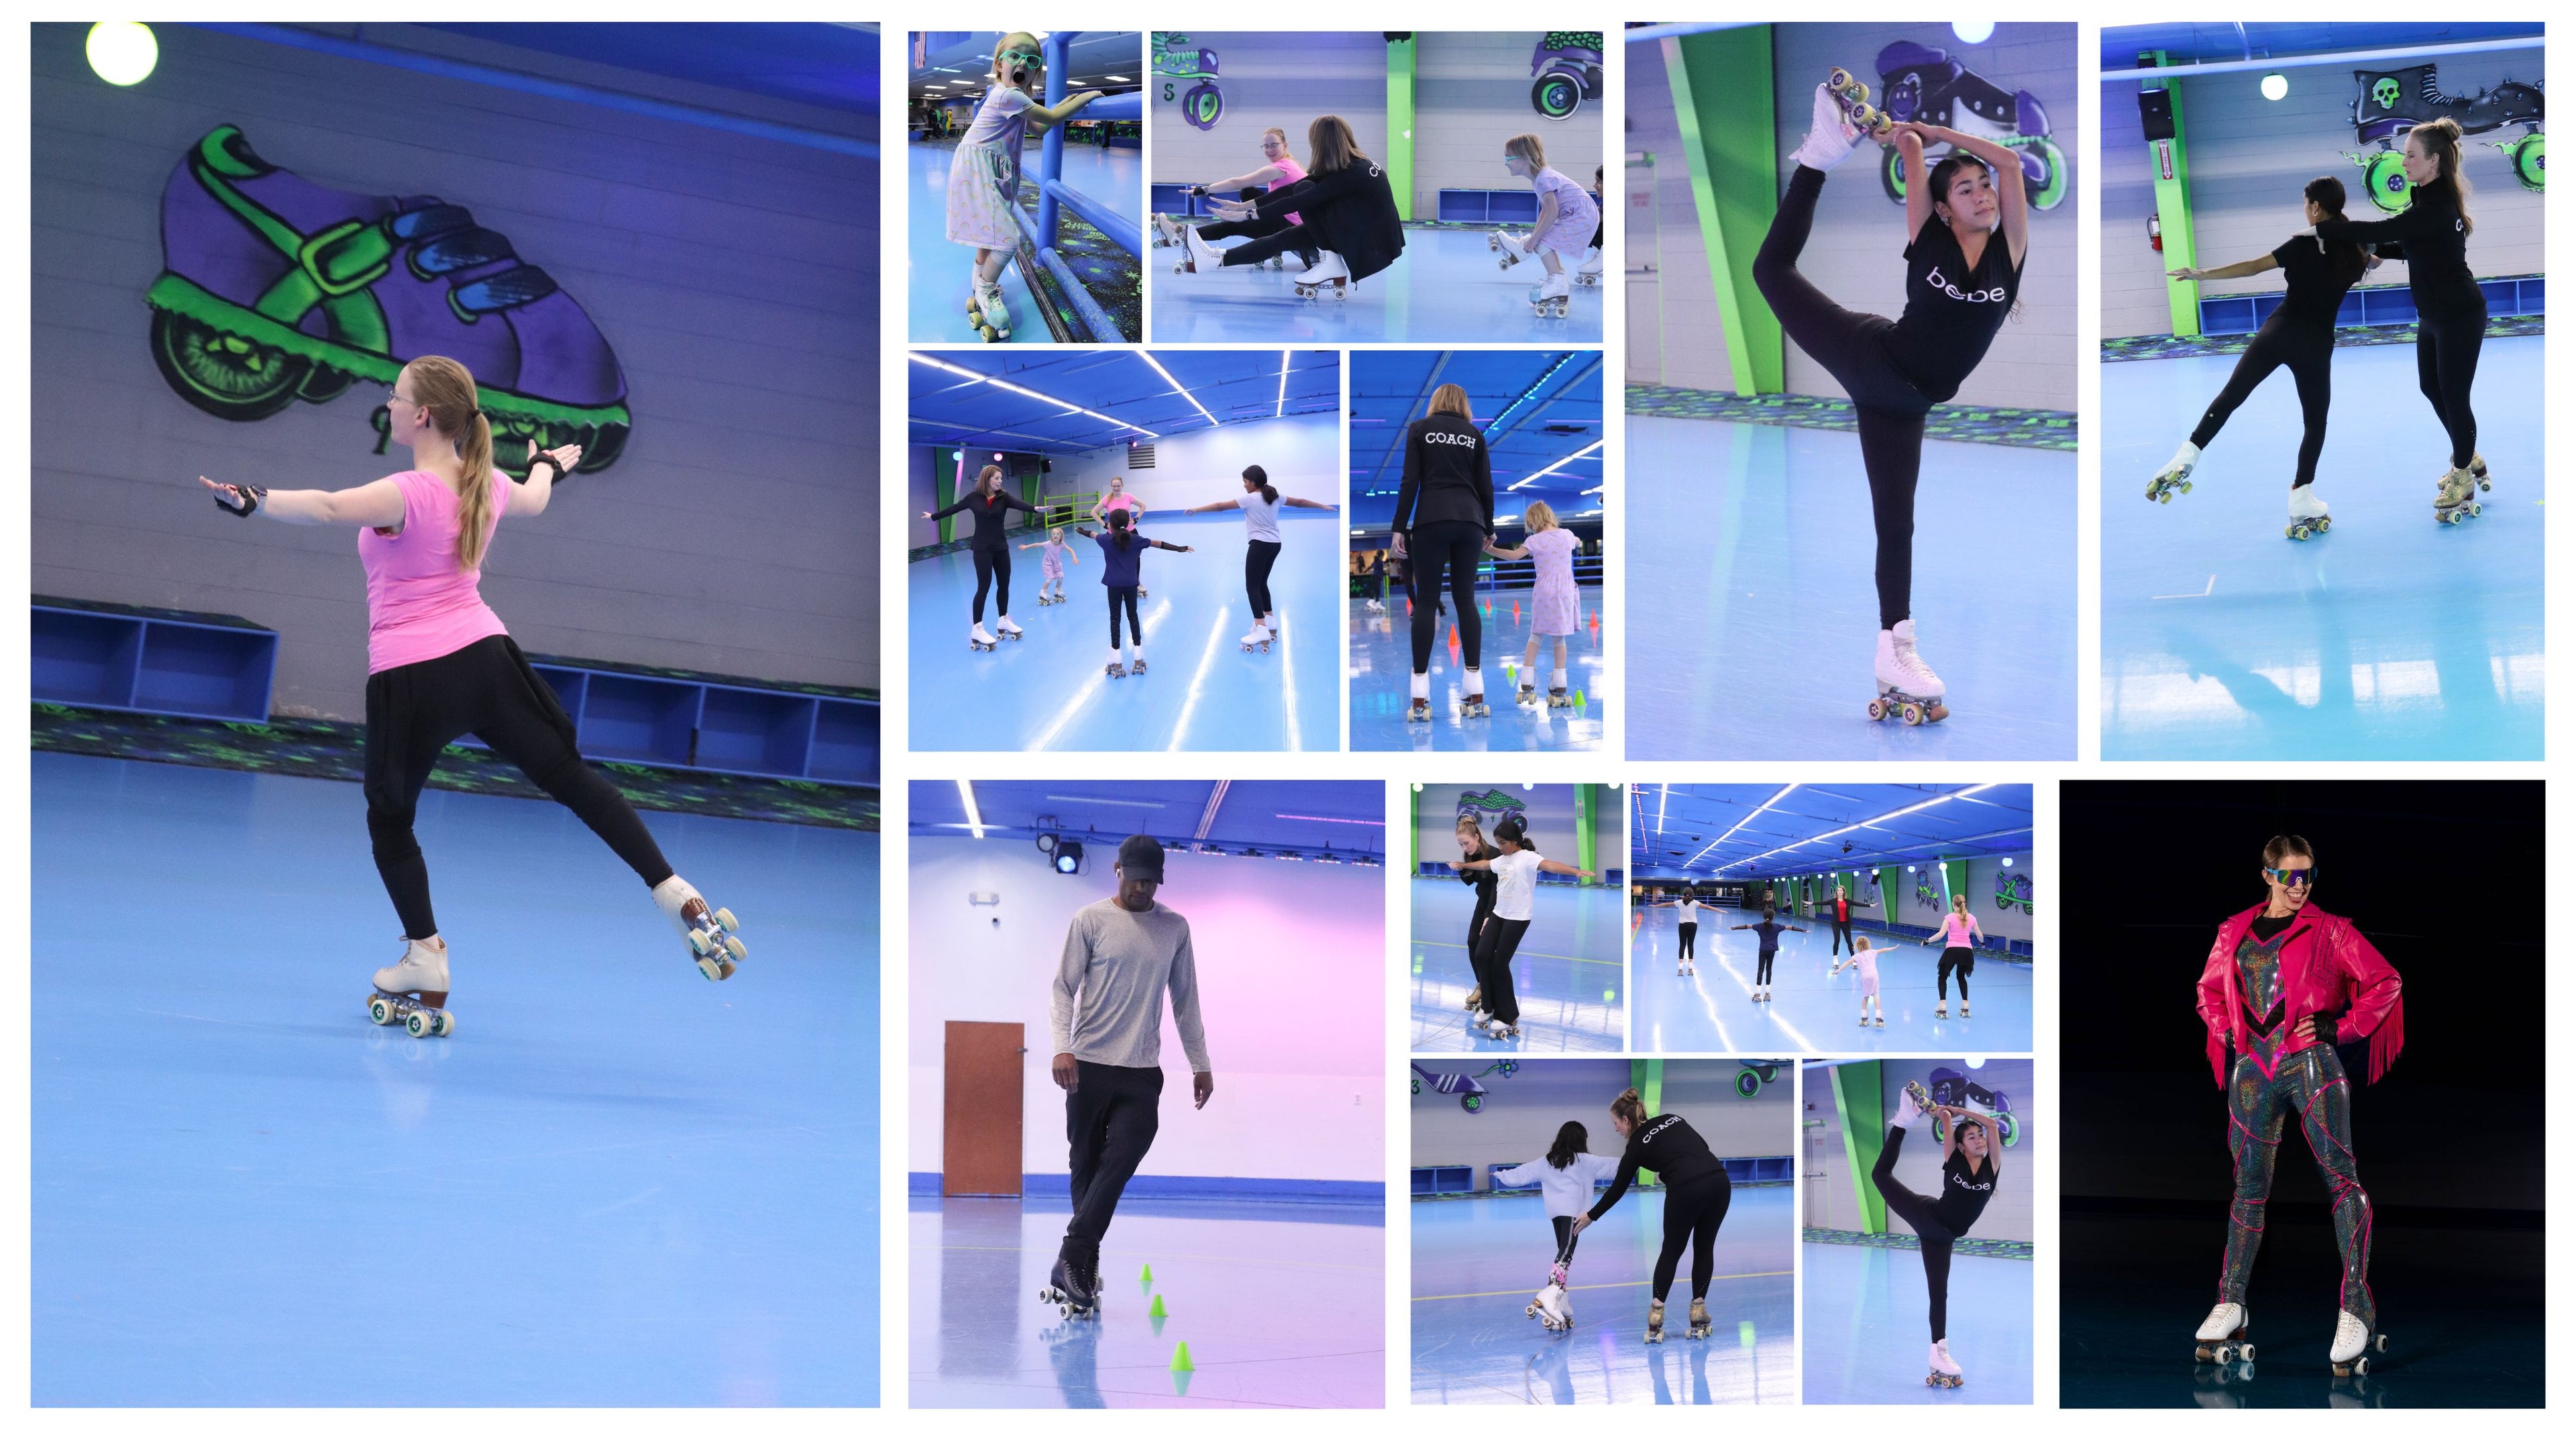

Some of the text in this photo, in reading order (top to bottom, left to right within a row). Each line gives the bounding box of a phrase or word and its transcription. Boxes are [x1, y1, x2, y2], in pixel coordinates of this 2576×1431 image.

[1425, 432, 1477, 449] COACH
[1411, 1079, 1420, 1094] 3
[1642, 1116, 1682, 1144] COACH
